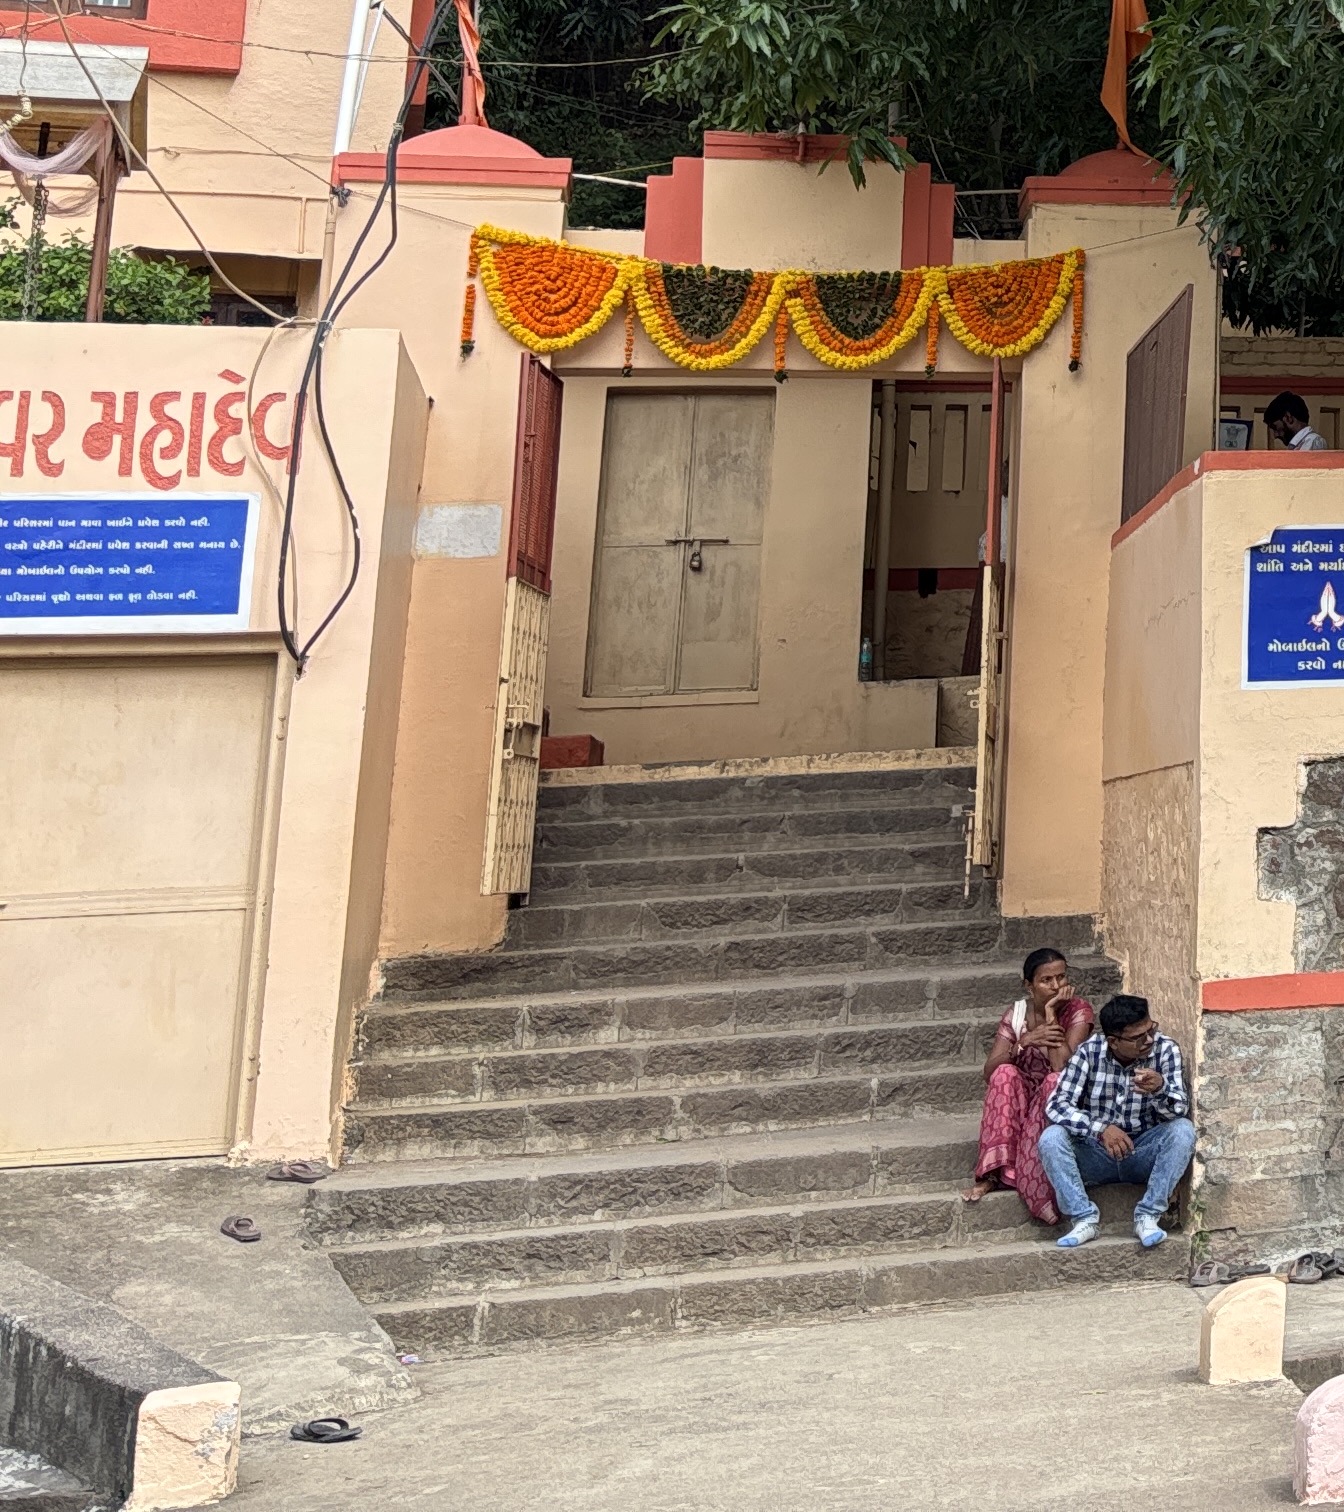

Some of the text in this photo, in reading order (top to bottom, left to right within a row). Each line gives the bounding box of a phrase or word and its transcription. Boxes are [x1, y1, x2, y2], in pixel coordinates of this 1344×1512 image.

[82, 368, 308, 491] મહાદેવ
[1256, 558, 1284, 572] શાંતિ
[1290, 559, 1313, 571] અને
[1268, 638, 1330, 652] મોબાઈલનો
[1297, 657, 1325, 670] કરવો
